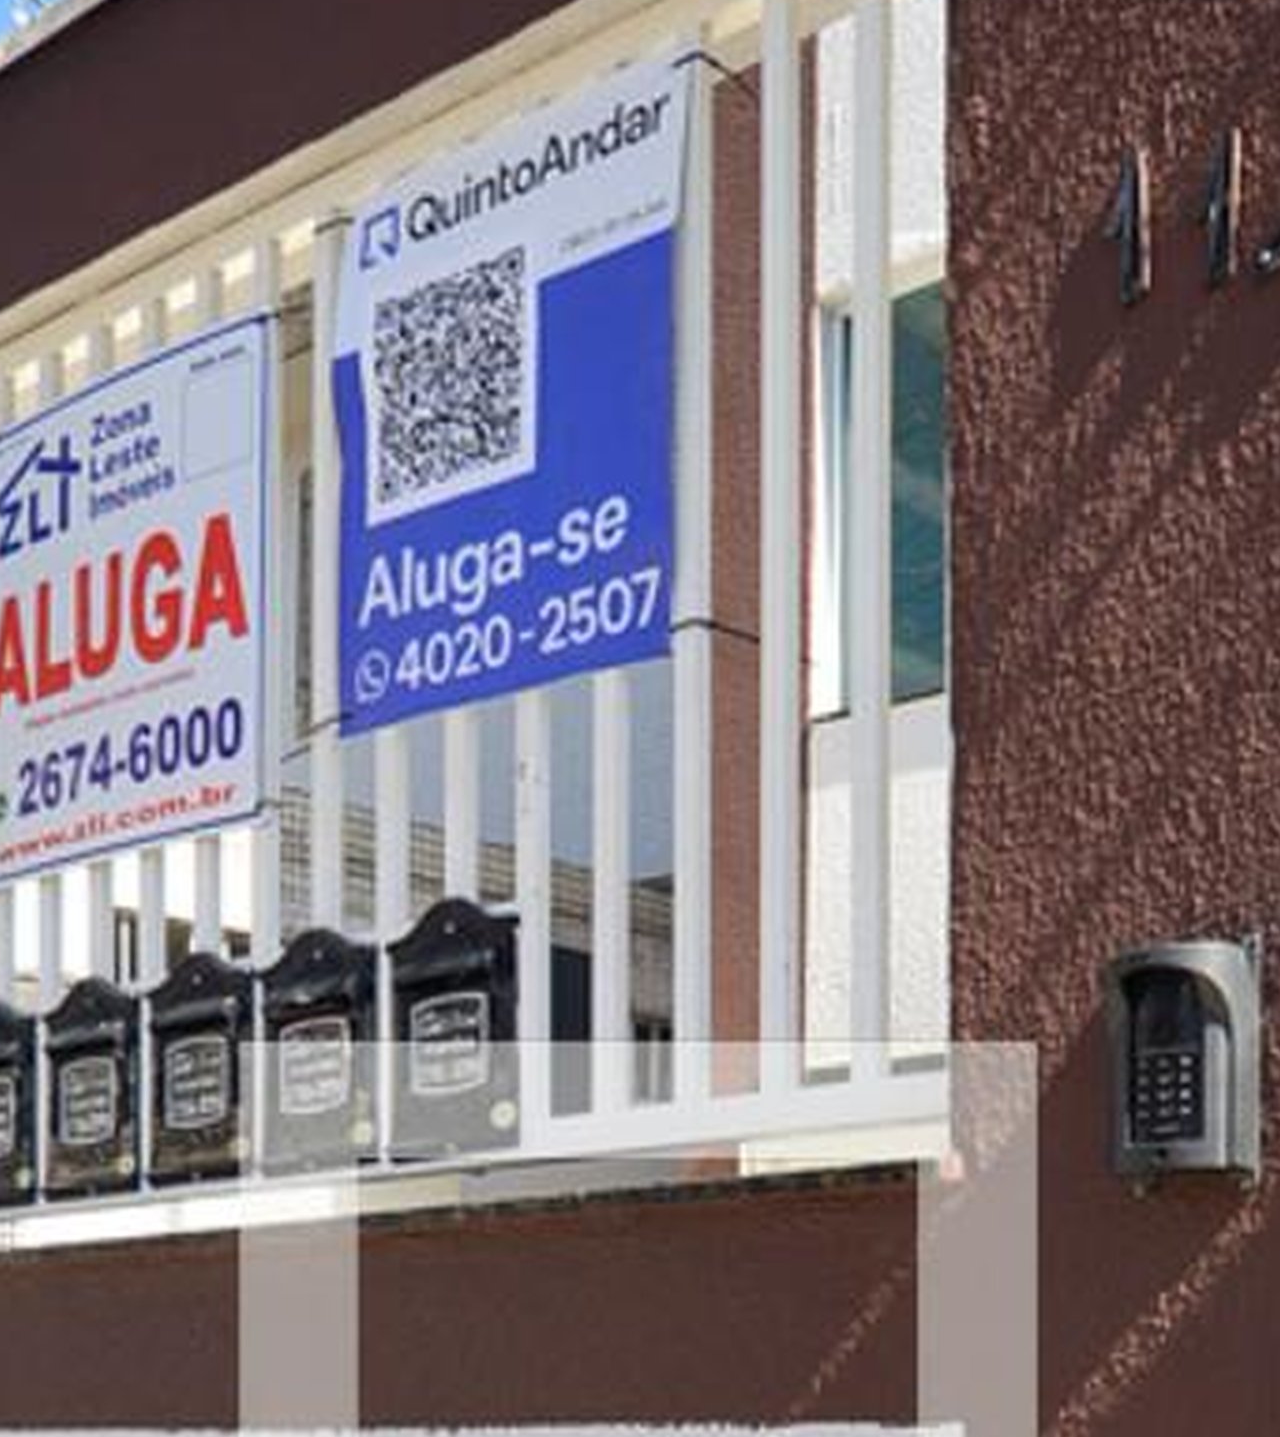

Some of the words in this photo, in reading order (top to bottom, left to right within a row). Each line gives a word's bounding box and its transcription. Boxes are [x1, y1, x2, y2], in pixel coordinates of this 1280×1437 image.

[403, 94, 671, 242] QuintoAndar
[89, 401, 152, 448] Zona
[89, 435, 161, 484] Leste
[358, 495, 628, 629] Aluga-se
[395, 567, 662, 690] 4020-2507
[17, 697, 242, 818] 2674-6000
